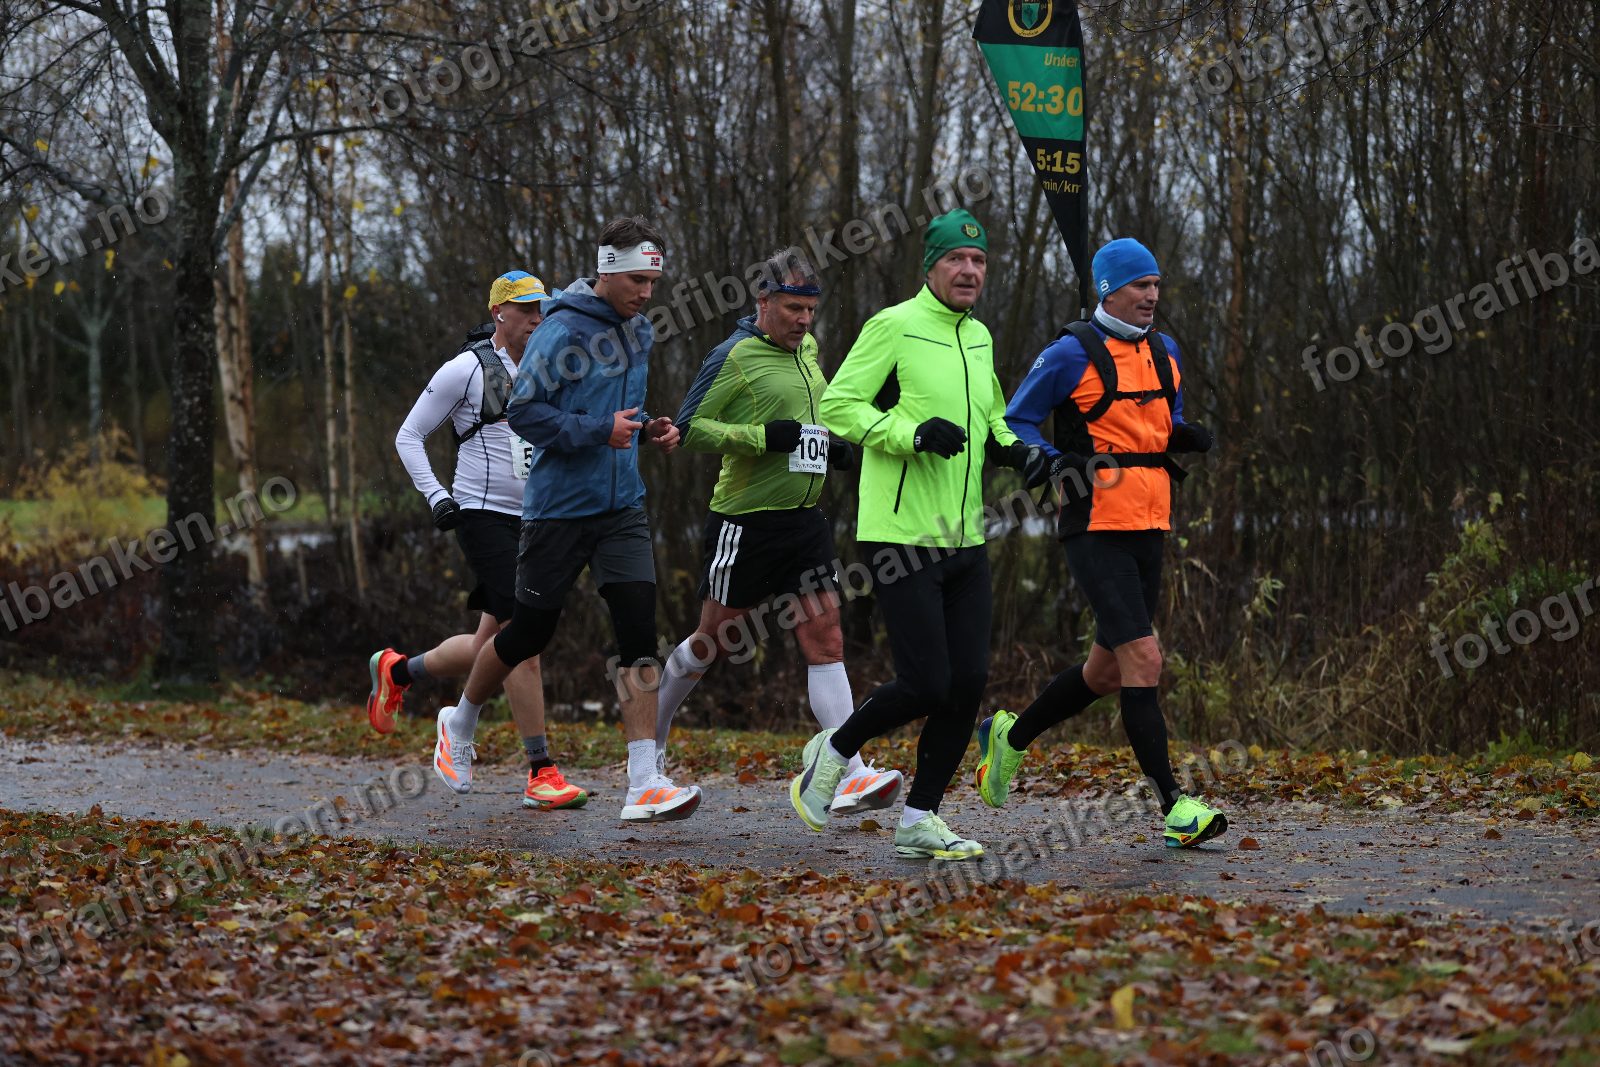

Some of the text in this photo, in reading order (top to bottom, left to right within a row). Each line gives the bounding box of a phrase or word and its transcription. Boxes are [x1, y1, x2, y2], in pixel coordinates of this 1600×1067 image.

[1044, 52, 1078, 68] Under
[1008, 81, 1083, 117] 52:30
[1036, 148, 1081, 175] 5:15
